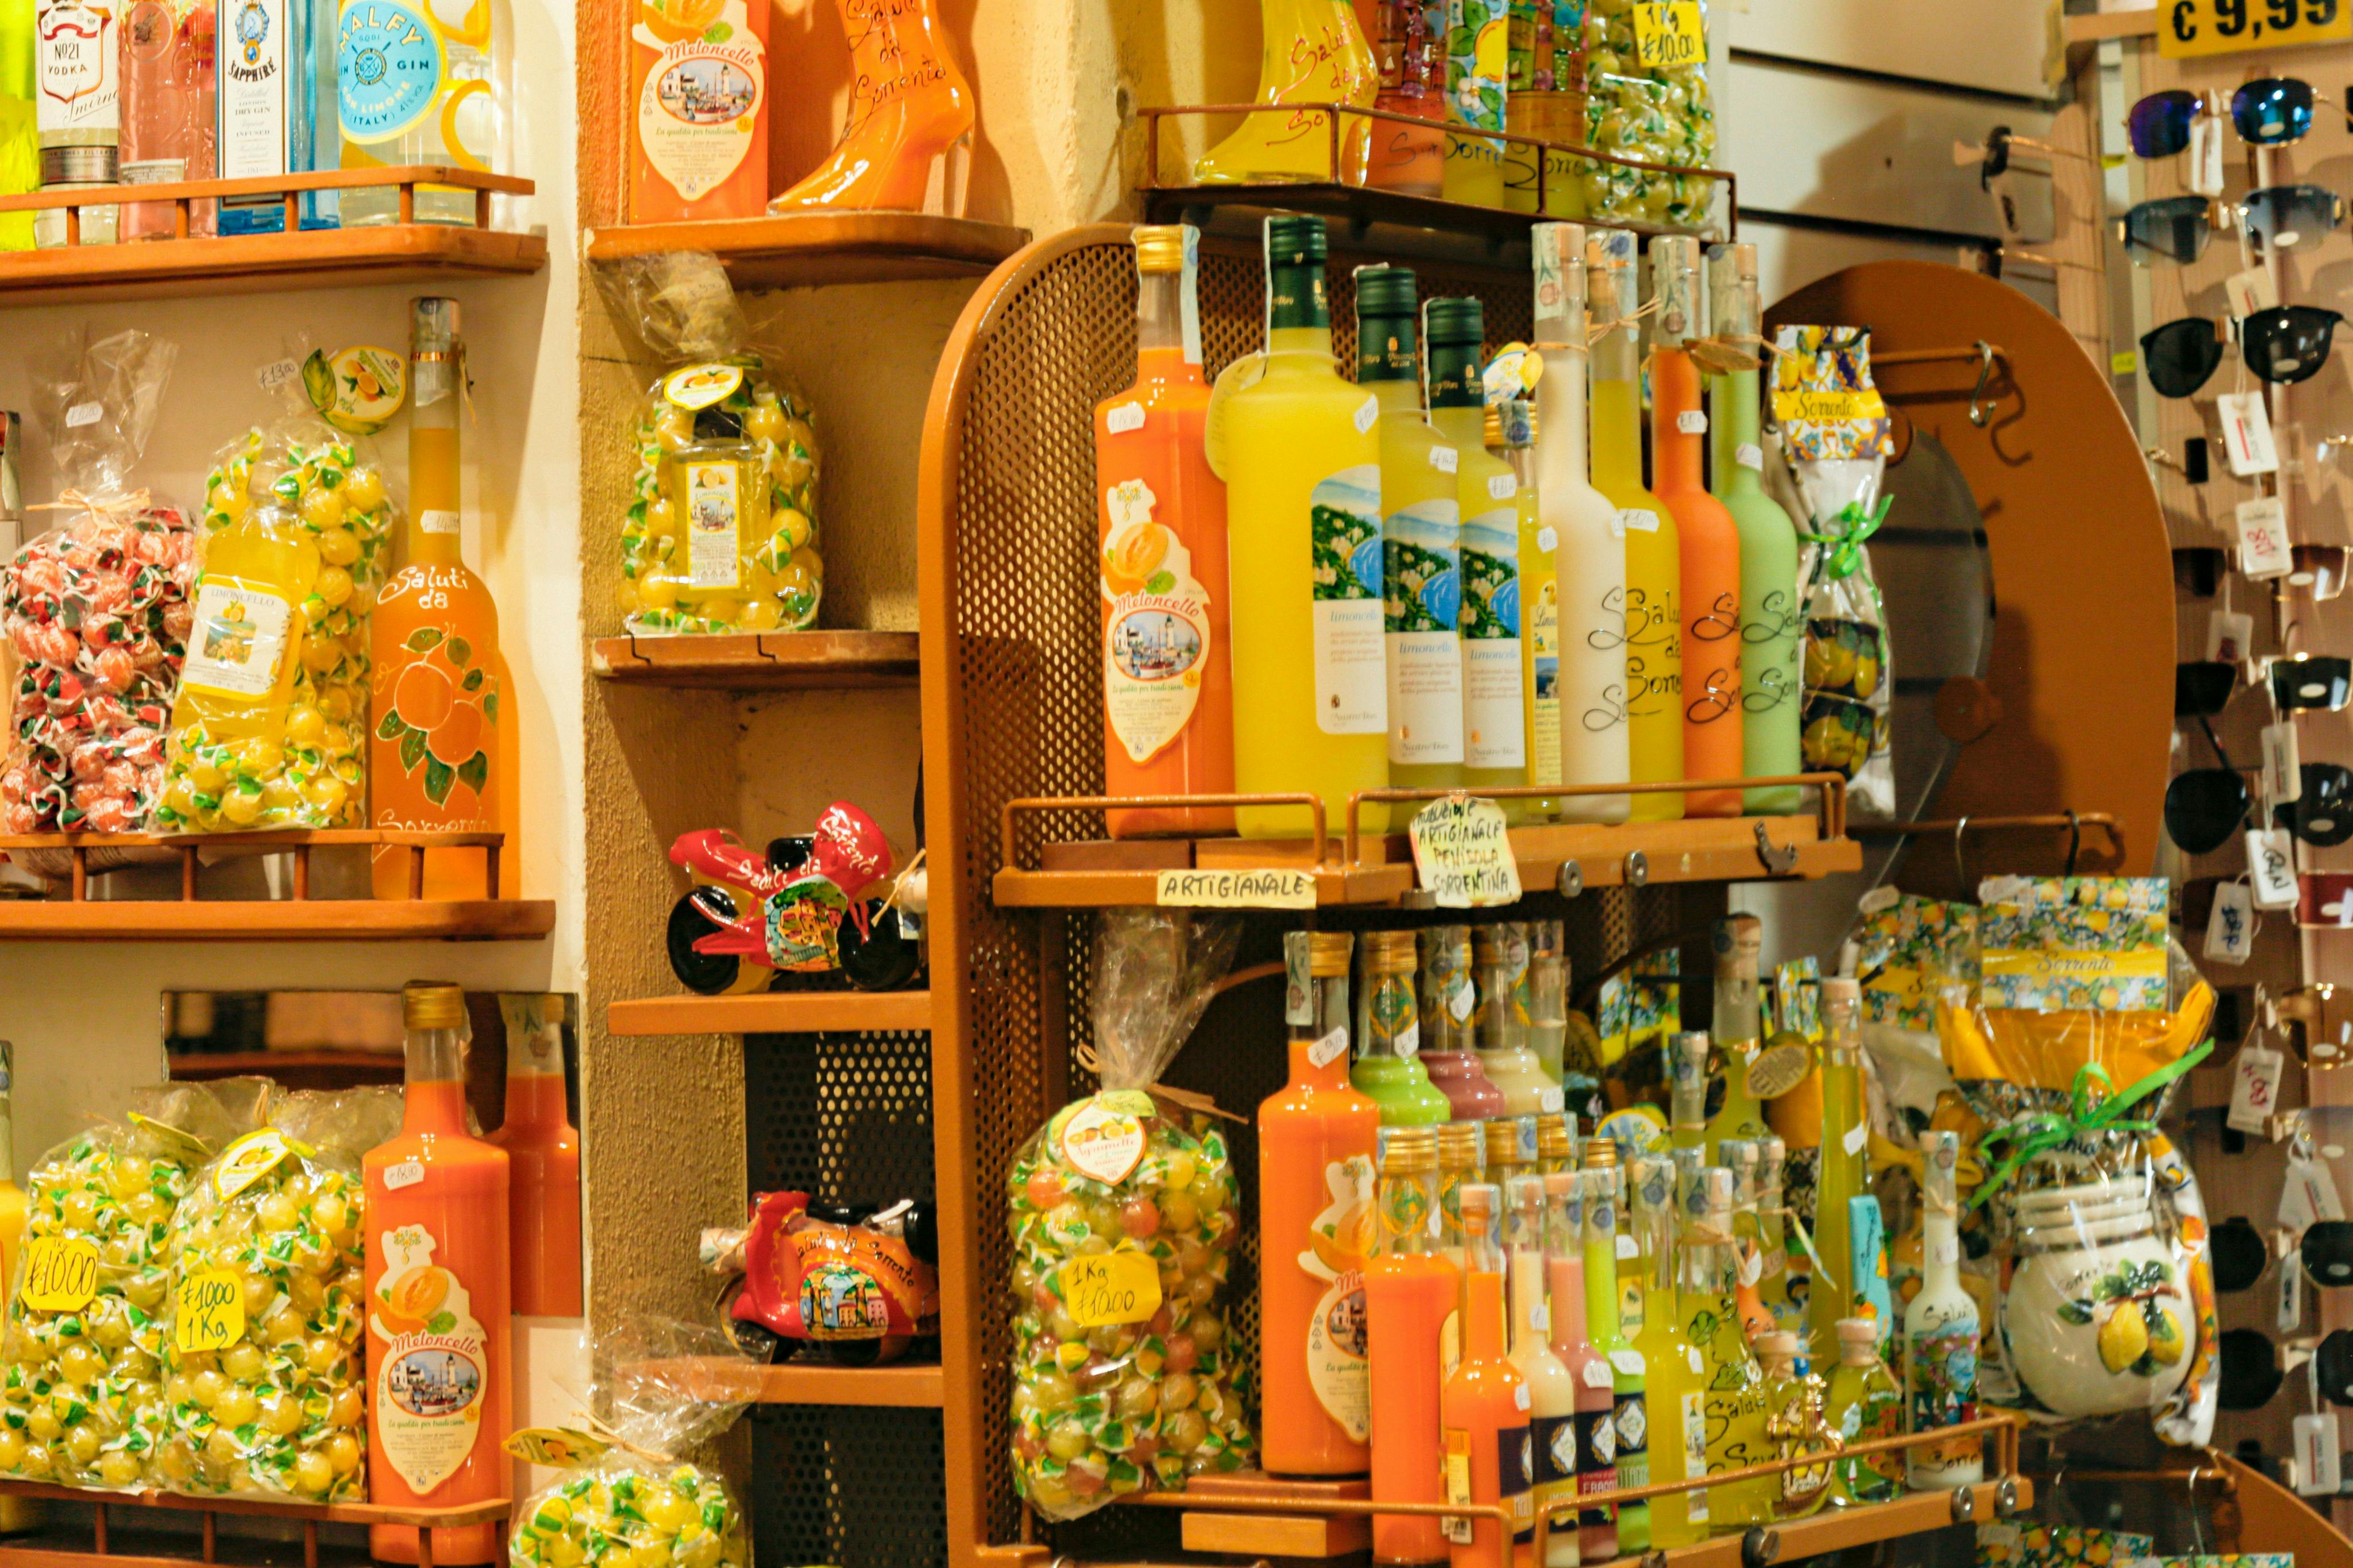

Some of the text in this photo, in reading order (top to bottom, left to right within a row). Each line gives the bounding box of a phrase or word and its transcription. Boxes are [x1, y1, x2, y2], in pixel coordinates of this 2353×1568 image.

[340, 6, 424, 55] MALFY
[2173, 1, 2196, 41] €
[397, 60, 429, 70] GIN
[665, 40, 754, 66] Meloncello
[48, 64, 87, 75] VODKA
[228, 56, 276, 83] SAPPHIRE
[848, 56, 946, 138] Sorrento
[1795, 392, 1855, 419] Sorrento
[211, 589, 275, 607] LIMONCELLO
[377, 566, 468, 605] Saluti
[419, 588, 448, 609] da
[1116, 592, 1199, 617] Meloncello
[1164, 874, 1306, 897] ARTIGIANALE
[2037, 951, 2115, 972] Sorrento
[1073, 1260, 1109, 1290] 1 Kg
[187, 1307, 229, 1348] 1 Kg
[392, 1331, 478, 1355] Meloncello
